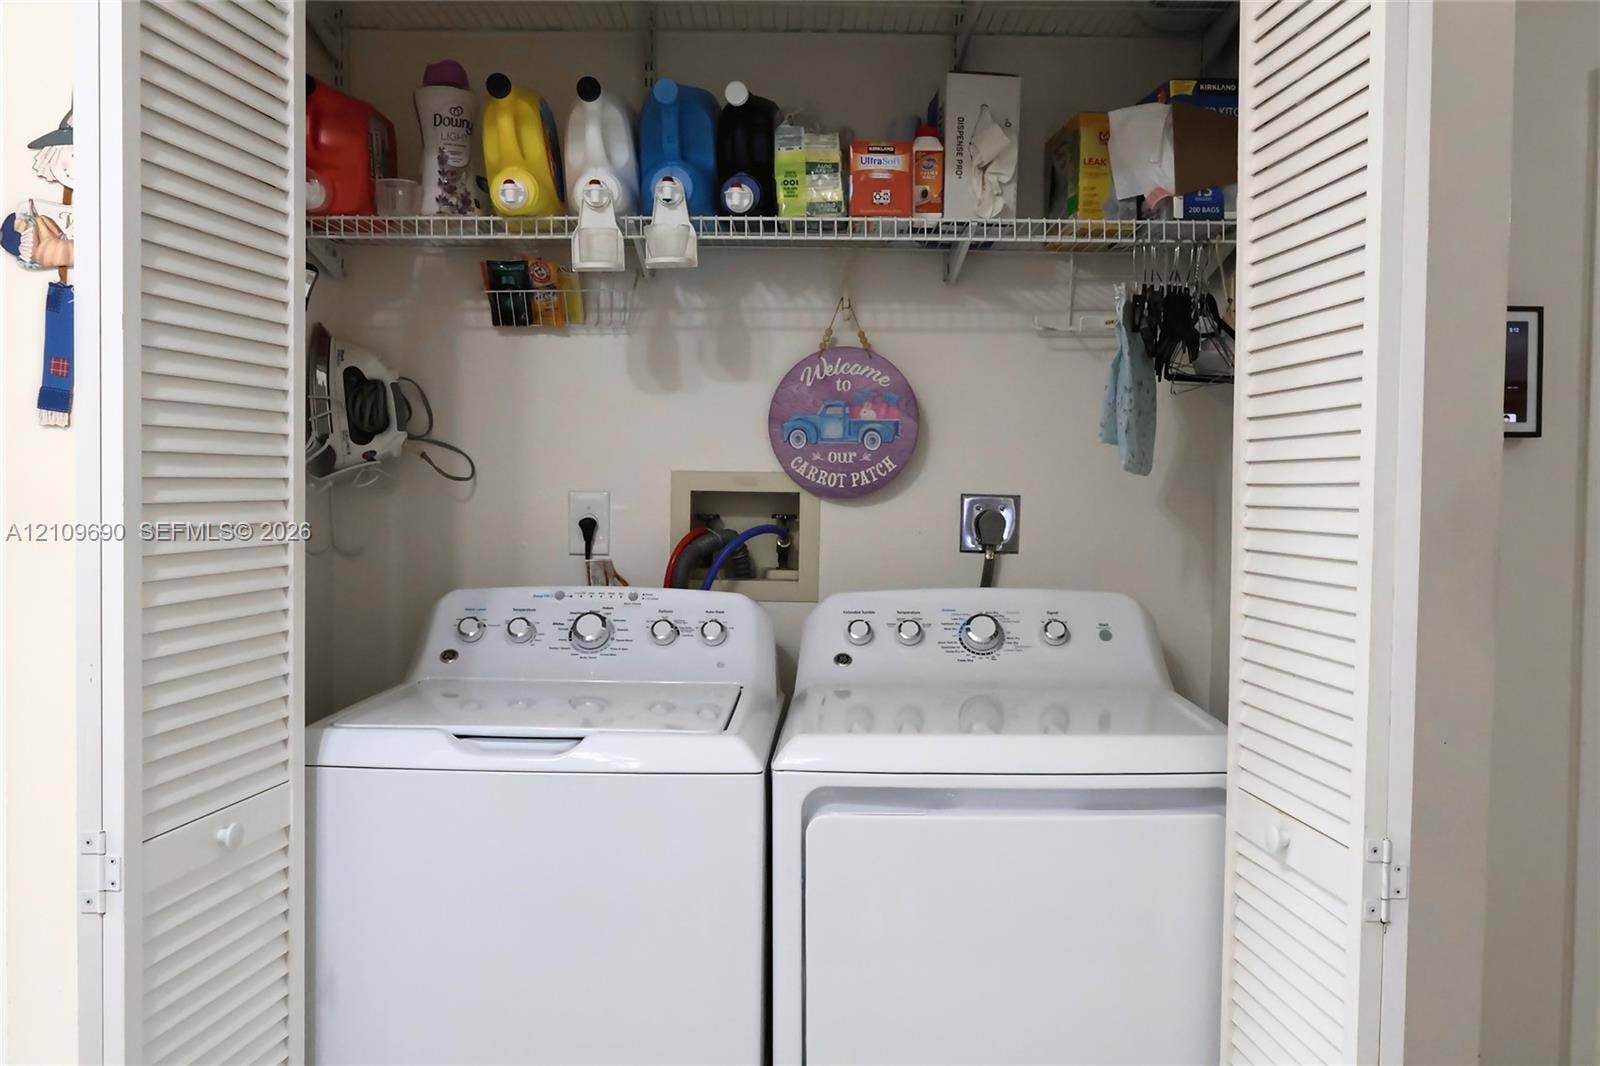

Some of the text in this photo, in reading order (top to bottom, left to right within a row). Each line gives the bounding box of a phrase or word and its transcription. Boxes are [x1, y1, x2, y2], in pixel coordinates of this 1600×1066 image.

[1199, 83, 1237, 91] KIRKLAND
[433, 113, 474, 136] Downy
[955, 116, 965, 158] DISPENSE
[1083, 158, 1107, 166] LEAK
[800, 357, 890, 387] Welcome
[836, 378, 852, 392] to
[828, 451, 857, 464] our
[790, 455, 897, 488] CARROT PATCH
